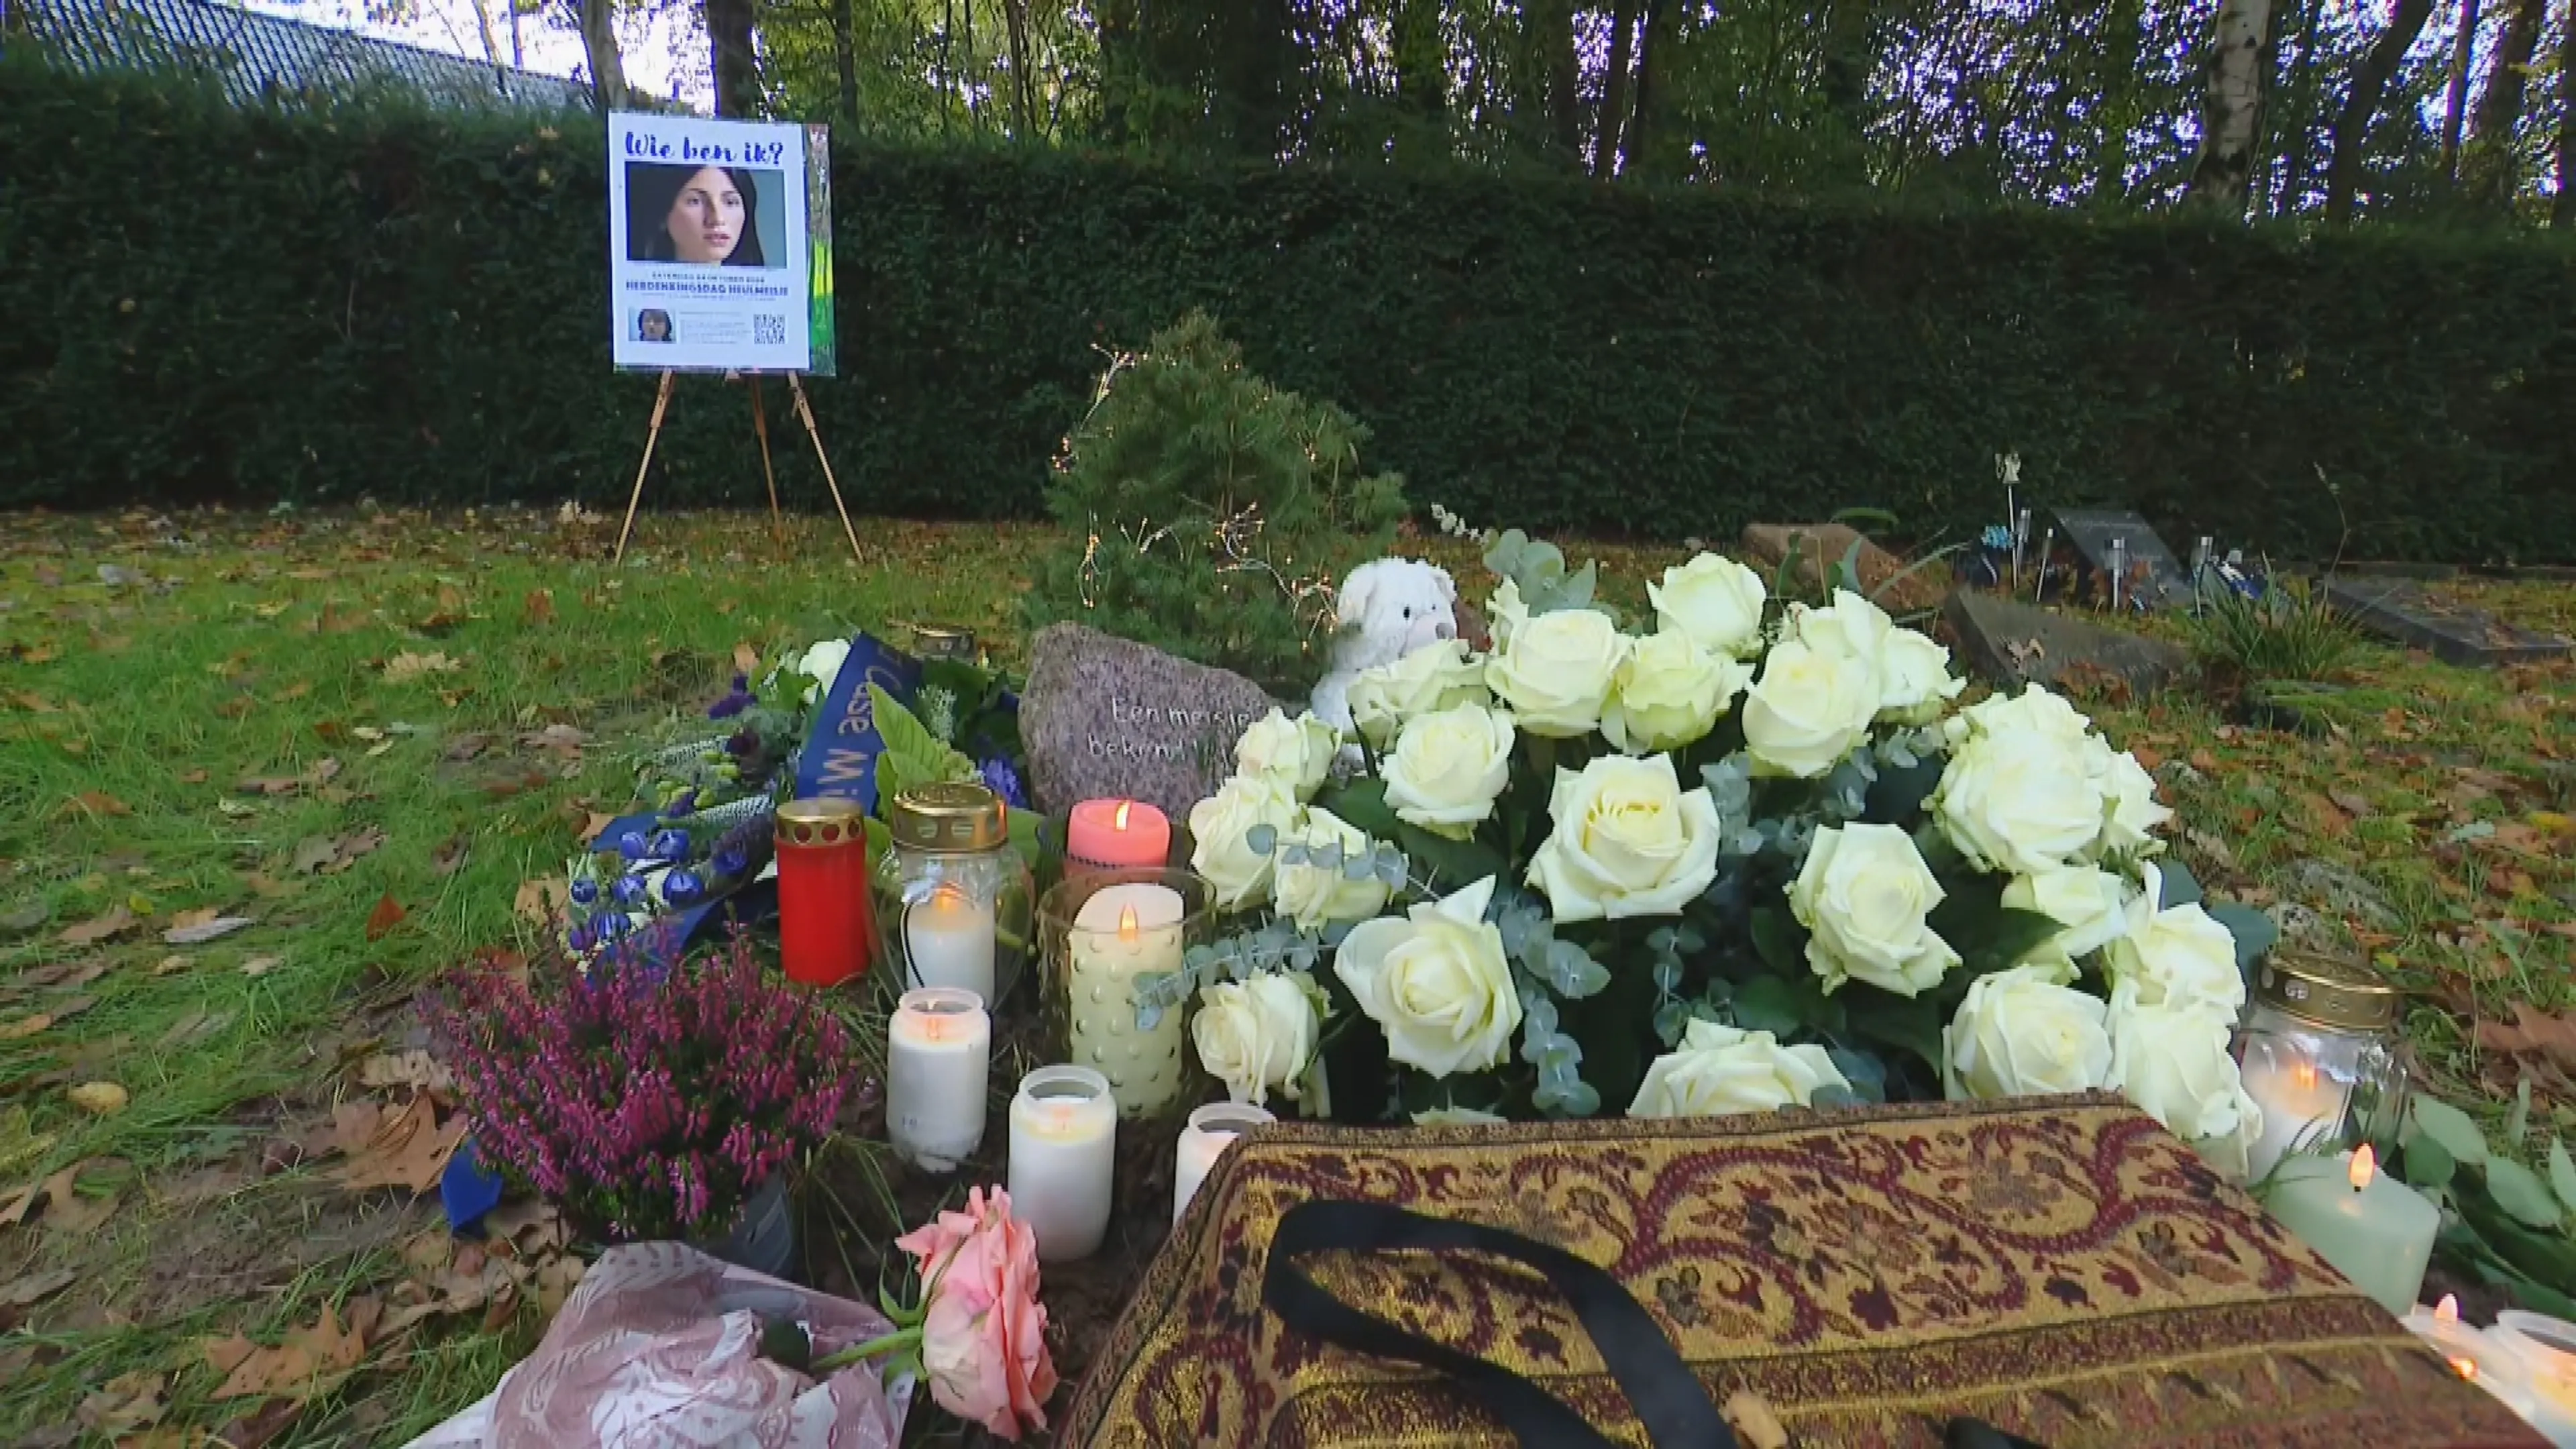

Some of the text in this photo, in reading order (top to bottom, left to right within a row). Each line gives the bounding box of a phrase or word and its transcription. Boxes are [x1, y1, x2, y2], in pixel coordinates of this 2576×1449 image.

[625, 131, 784, 166] Wie ben ik?
[1112, 697, 1160, 723] Een
